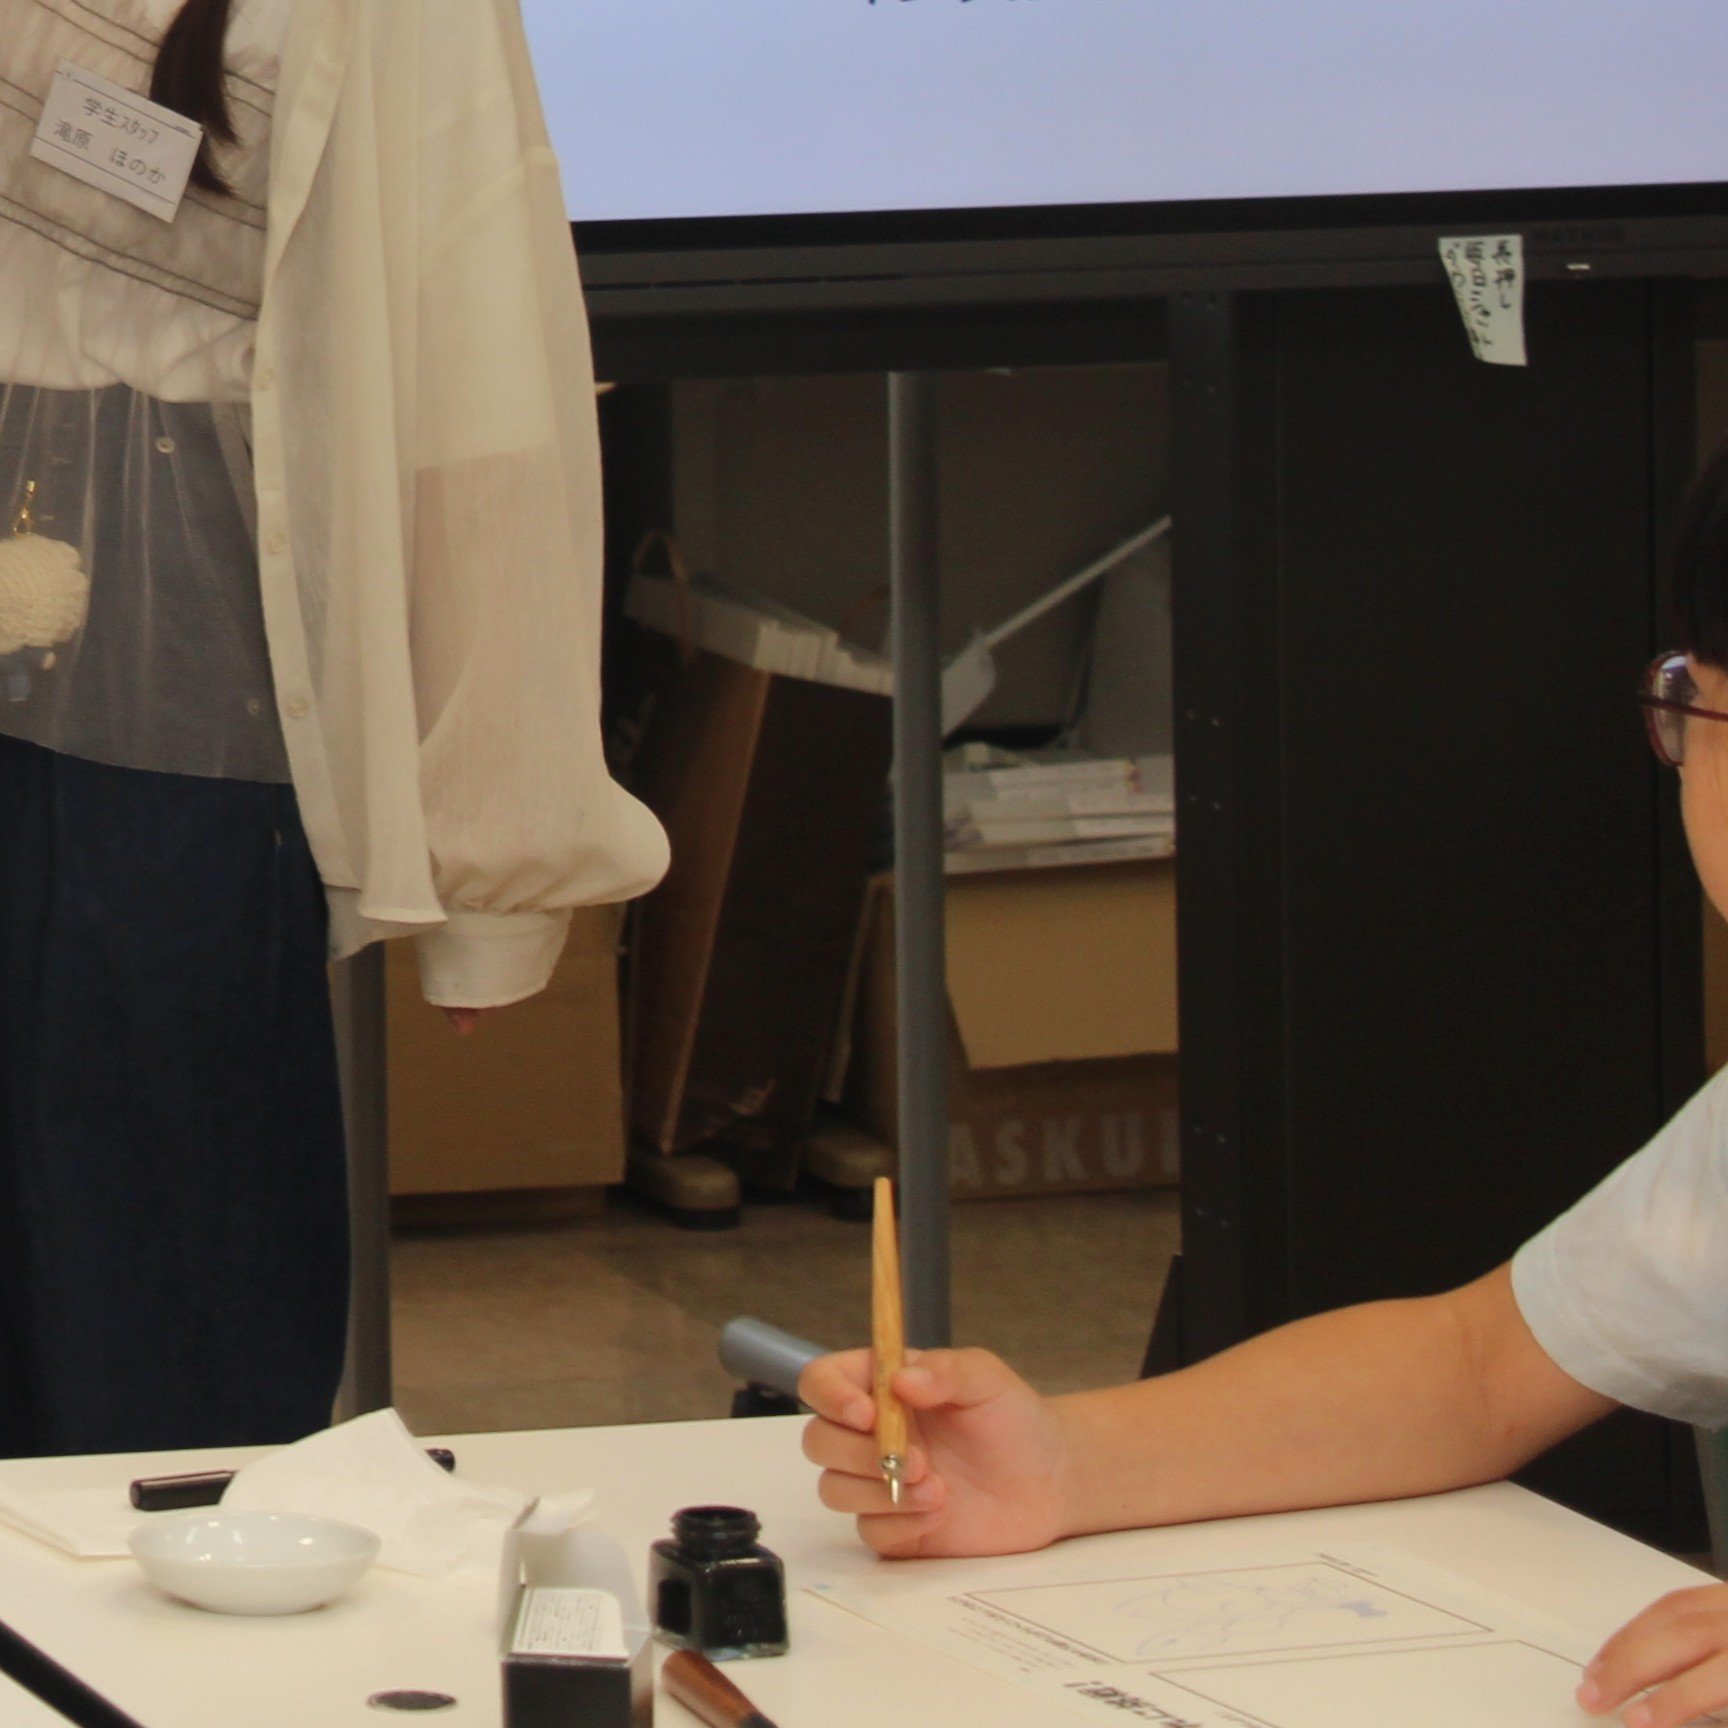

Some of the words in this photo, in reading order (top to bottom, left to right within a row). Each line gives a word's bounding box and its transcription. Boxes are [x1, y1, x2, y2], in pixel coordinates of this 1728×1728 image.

[83, 97, 159, 144] 学生スタッフ
[110, 148, 166, 184] ほのか
